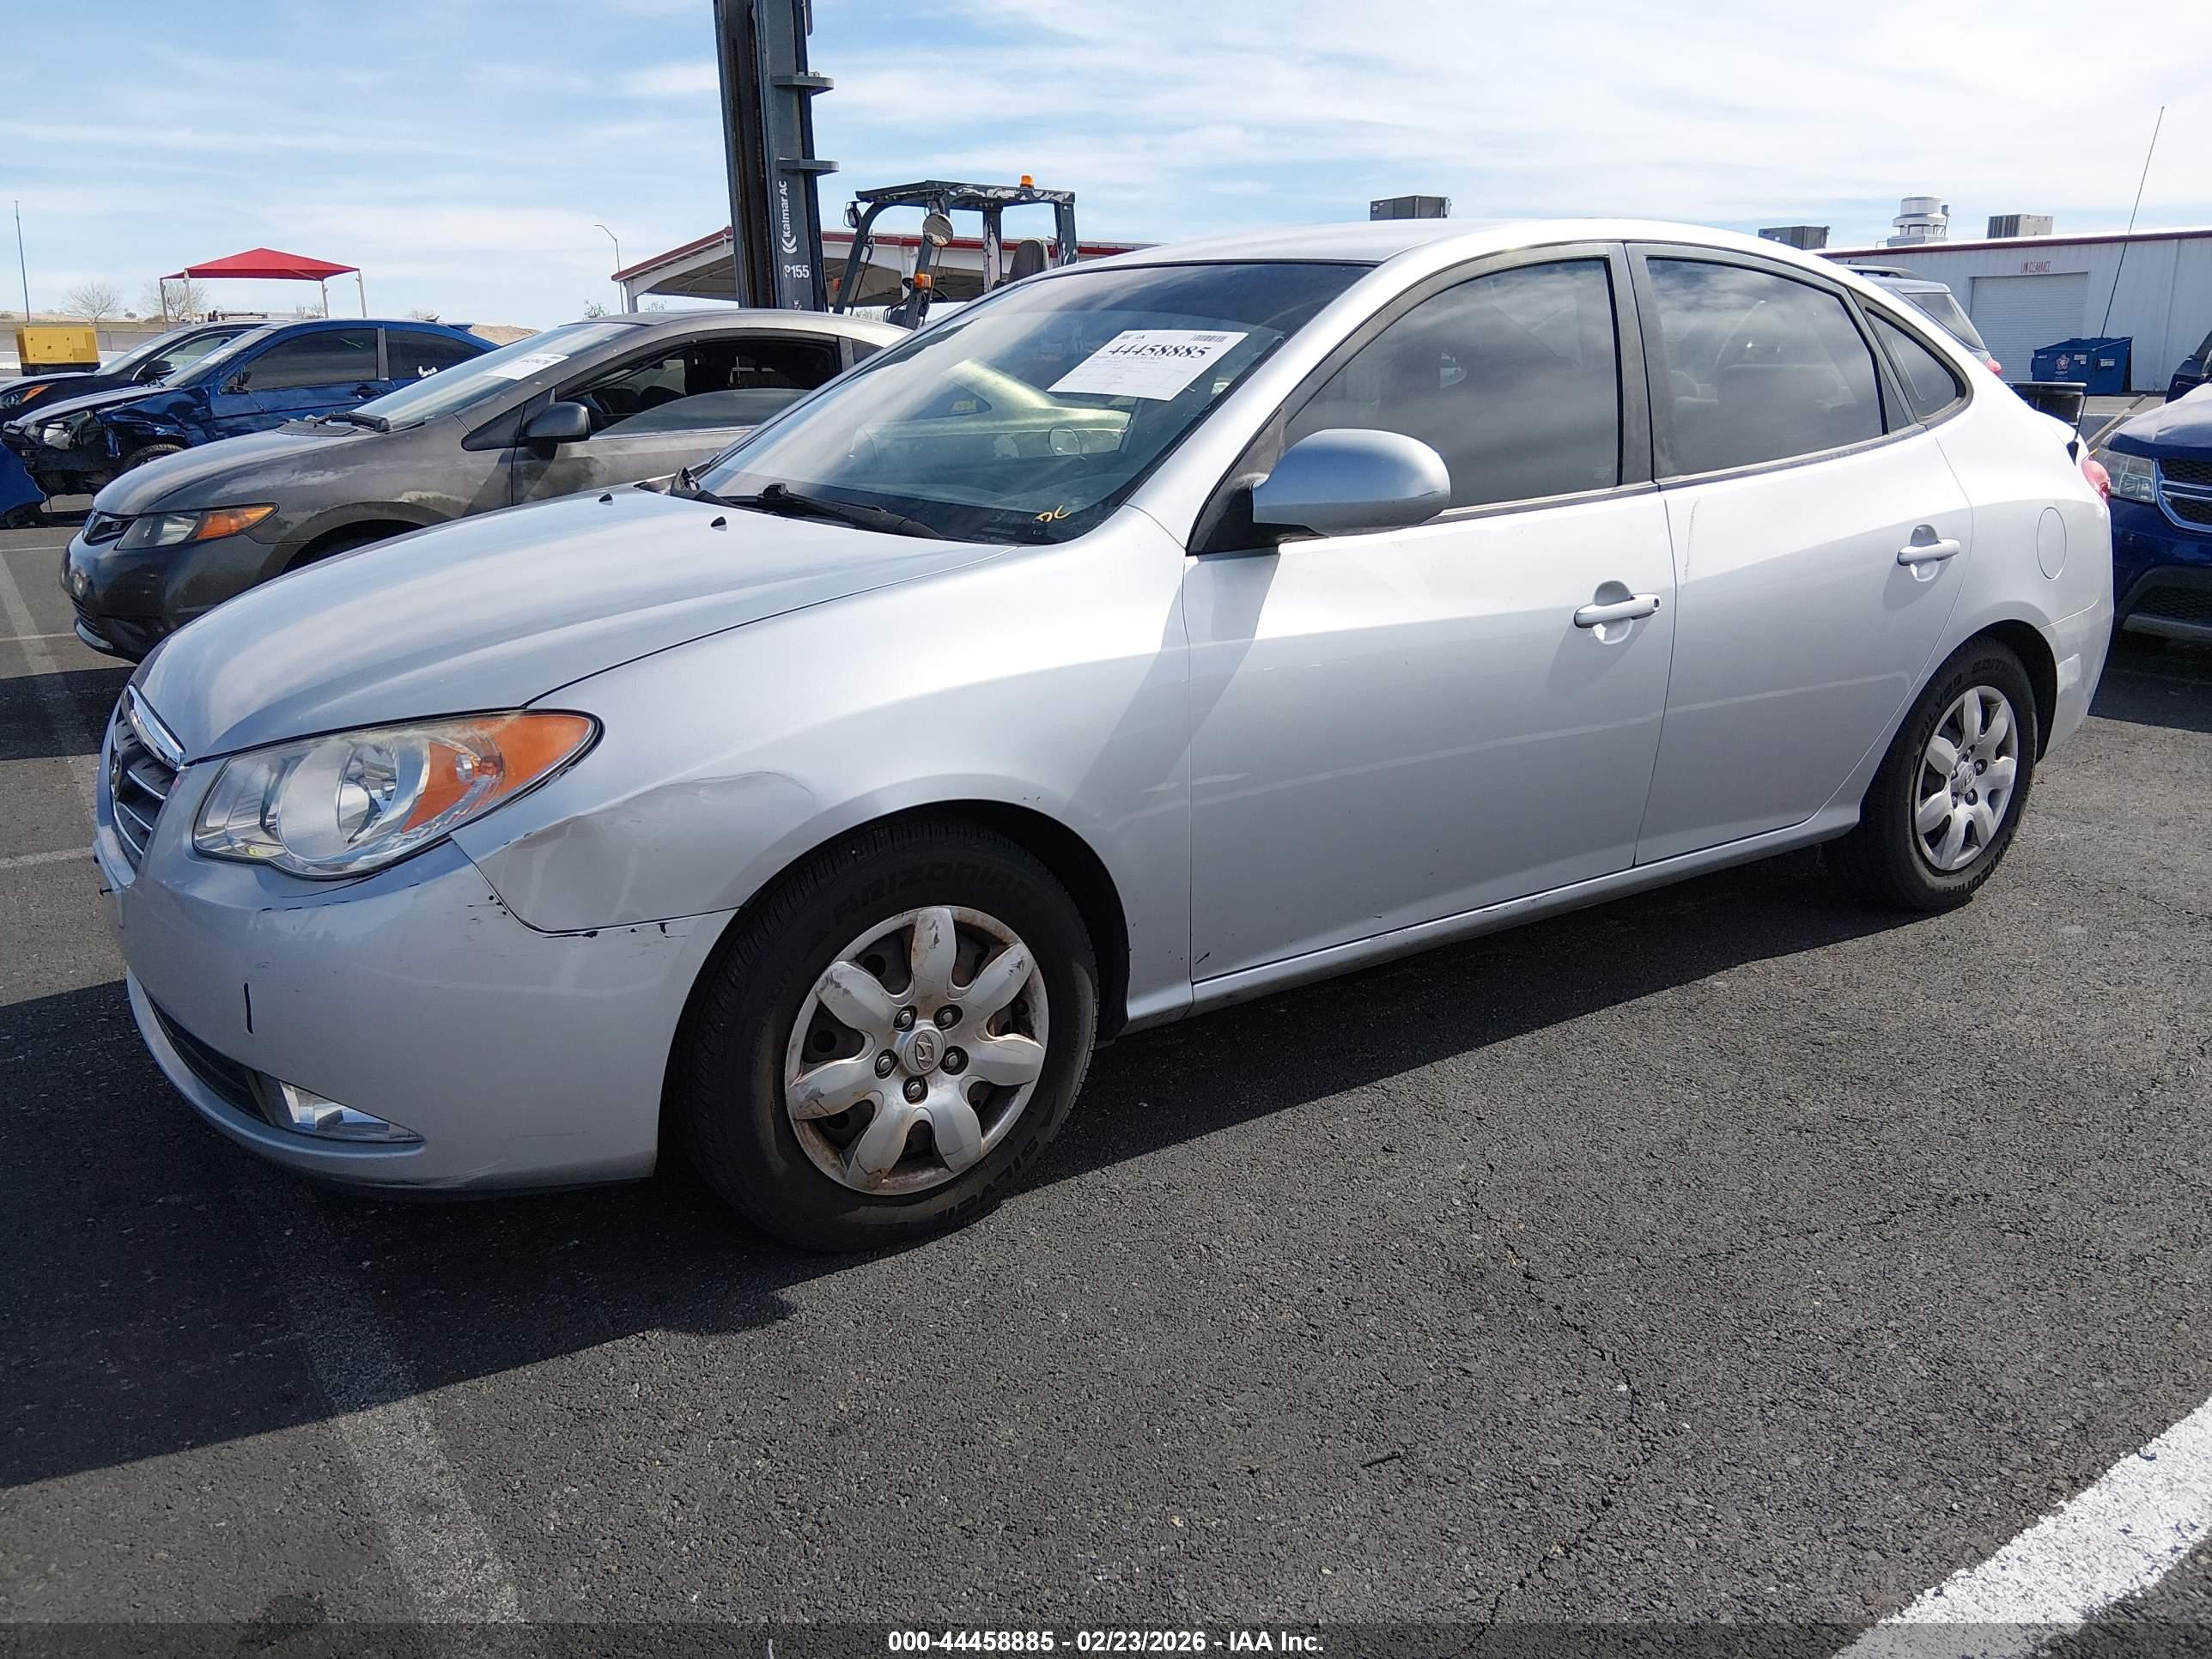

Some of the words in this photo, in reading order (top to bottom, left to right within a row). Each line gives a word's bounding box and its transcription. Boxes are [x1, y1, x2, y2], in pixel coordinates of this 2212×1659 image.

[778, 180, 788, 196] AC
[781, 197, 791, 238] Kalmar
[1108, 343, 1212, 359] 44458885
